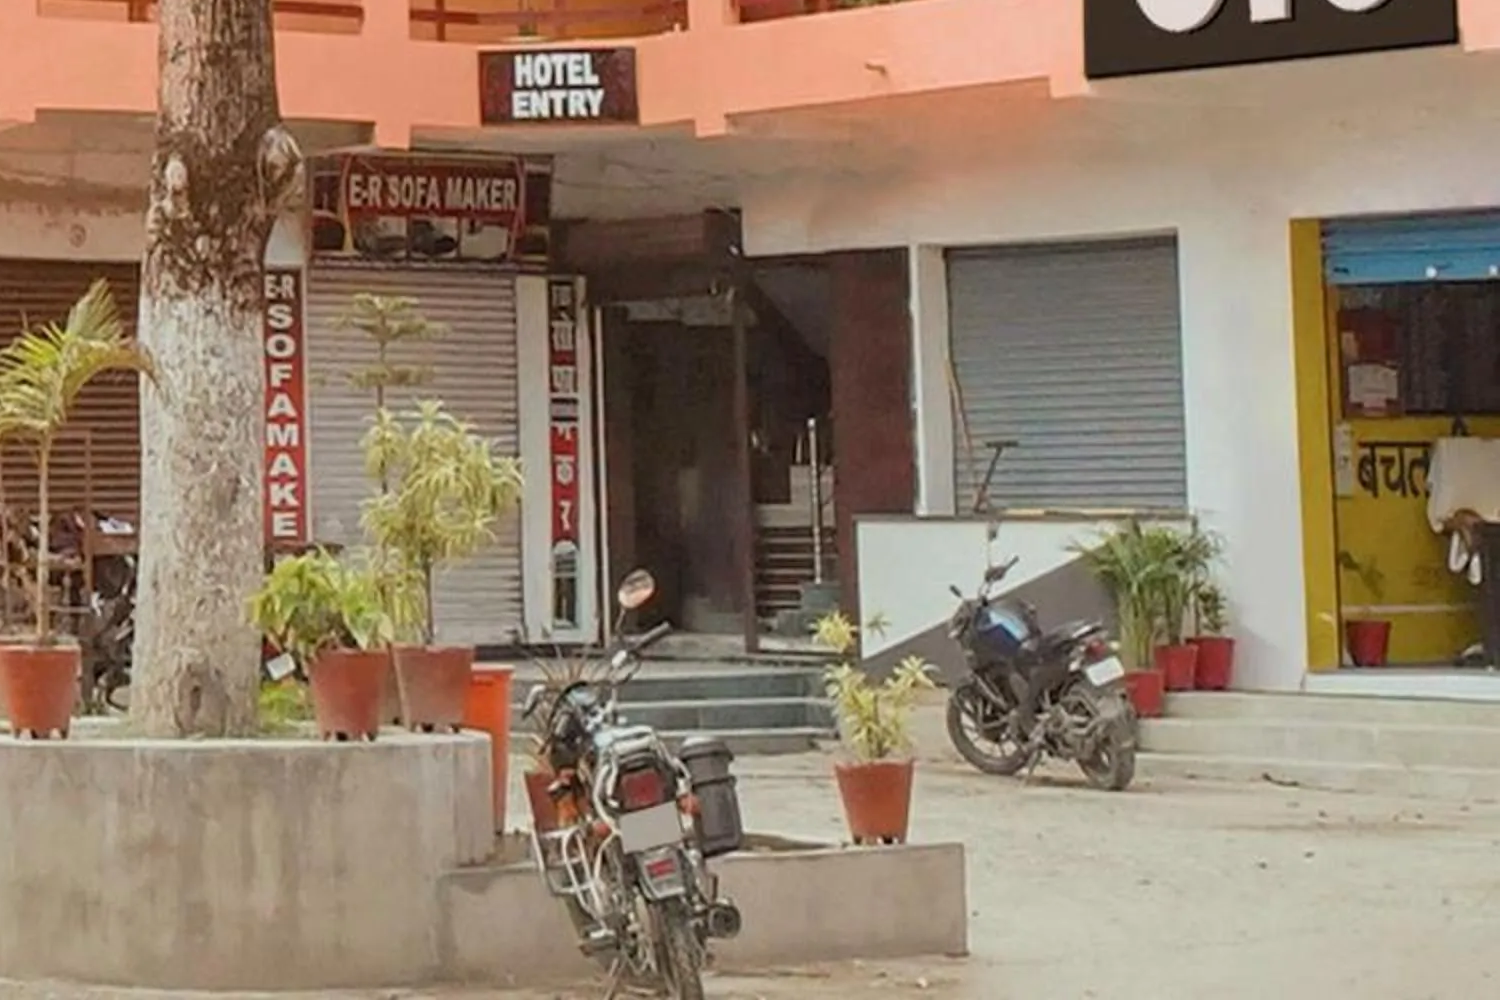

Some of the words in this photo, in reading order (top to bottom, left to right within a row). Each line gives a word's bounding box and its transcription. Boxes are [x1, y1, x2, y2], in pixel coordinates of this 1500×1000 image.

[514, 53, 599, 87] HOTEL
[512, 89, 604, 118] ENTRY
[387, 177, 439, 208] SOFA
[446, 177, 516, 210] MAKER
